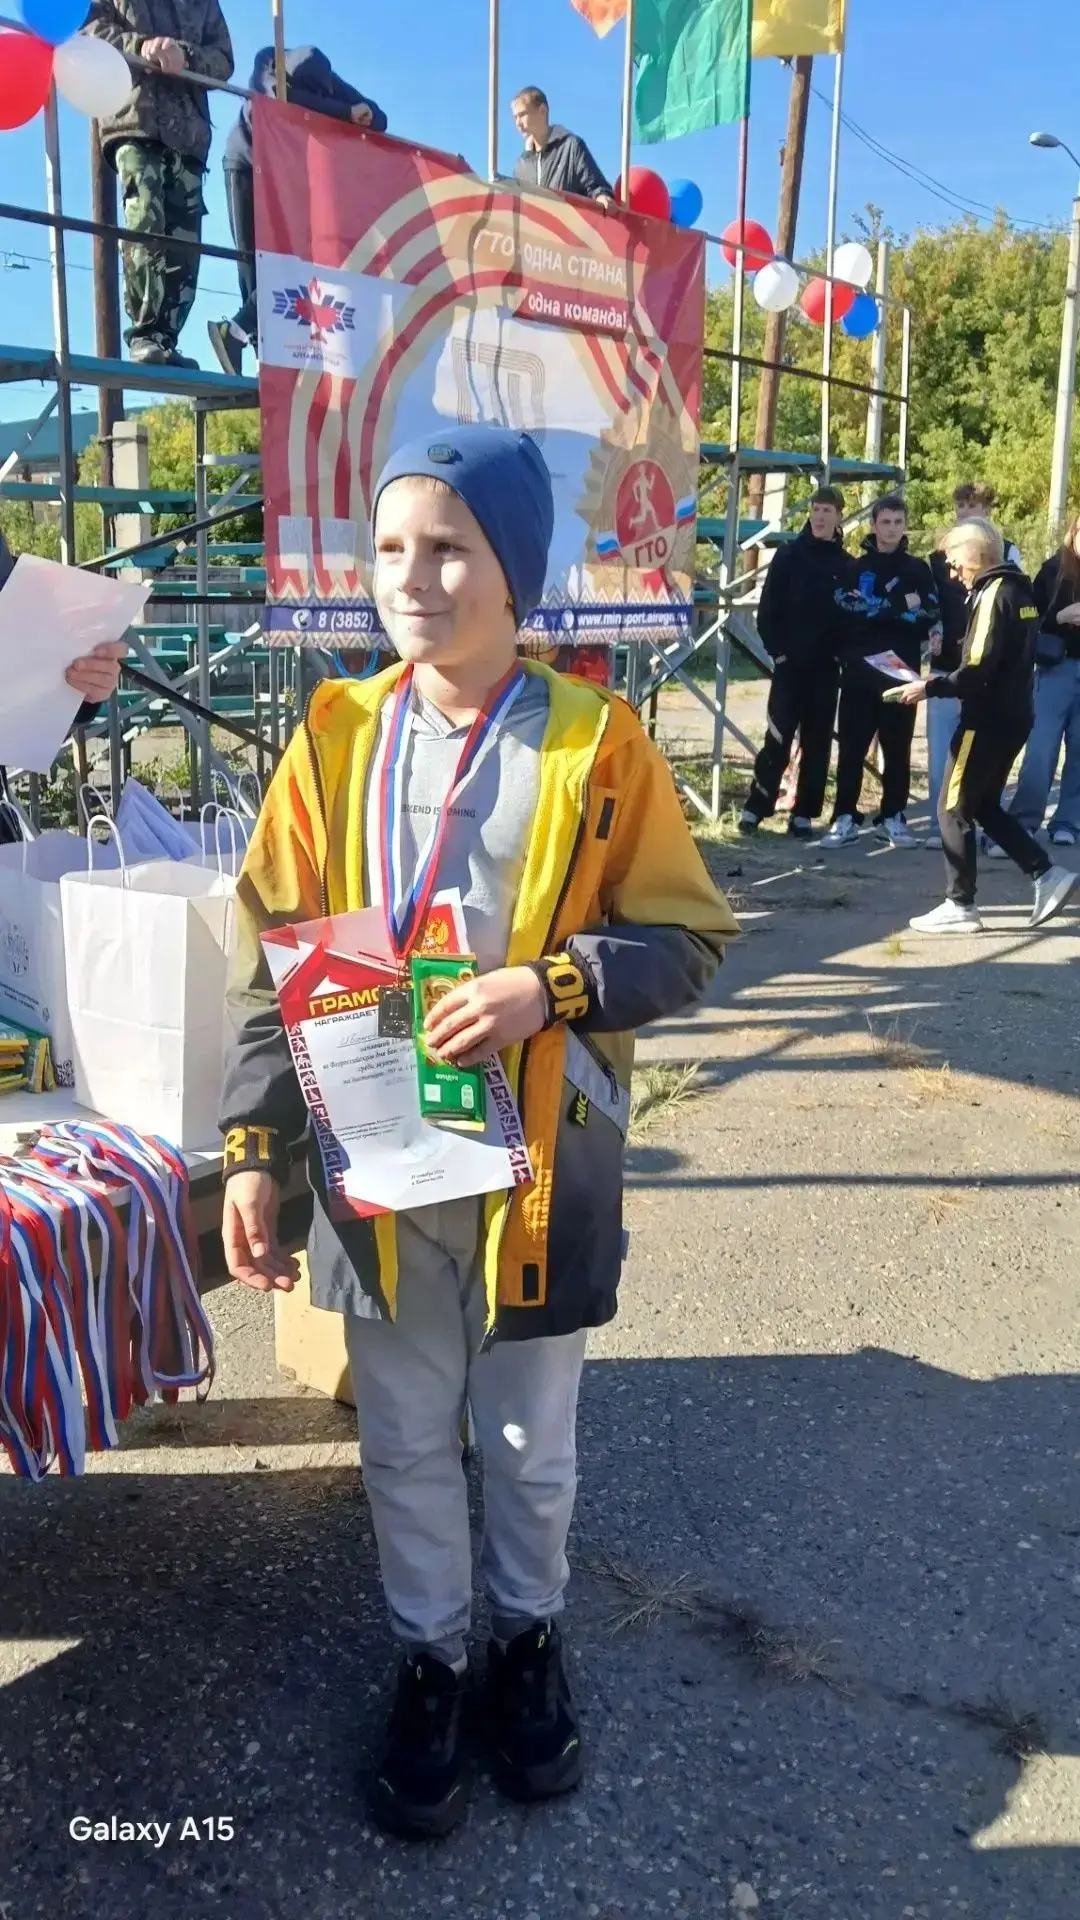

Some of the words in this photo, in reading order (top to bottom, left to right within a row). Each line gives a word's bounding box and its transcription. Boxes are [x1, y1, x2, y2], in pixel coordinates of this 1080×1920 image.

[473, 229, 515, 257] ГТО
[523, 242, 562, 273] ОДНА
[567, 255, 627, 291] СТРАНА,
[528, 291, 561, 317] одна
[564, 302, 627, 330] команда!
[635, 536, 667, 567] ГТО
[318, 612, 326, 628] 8
[330, 612, 374, 631] (3852)
[446, 807, 476, 818] OMING
